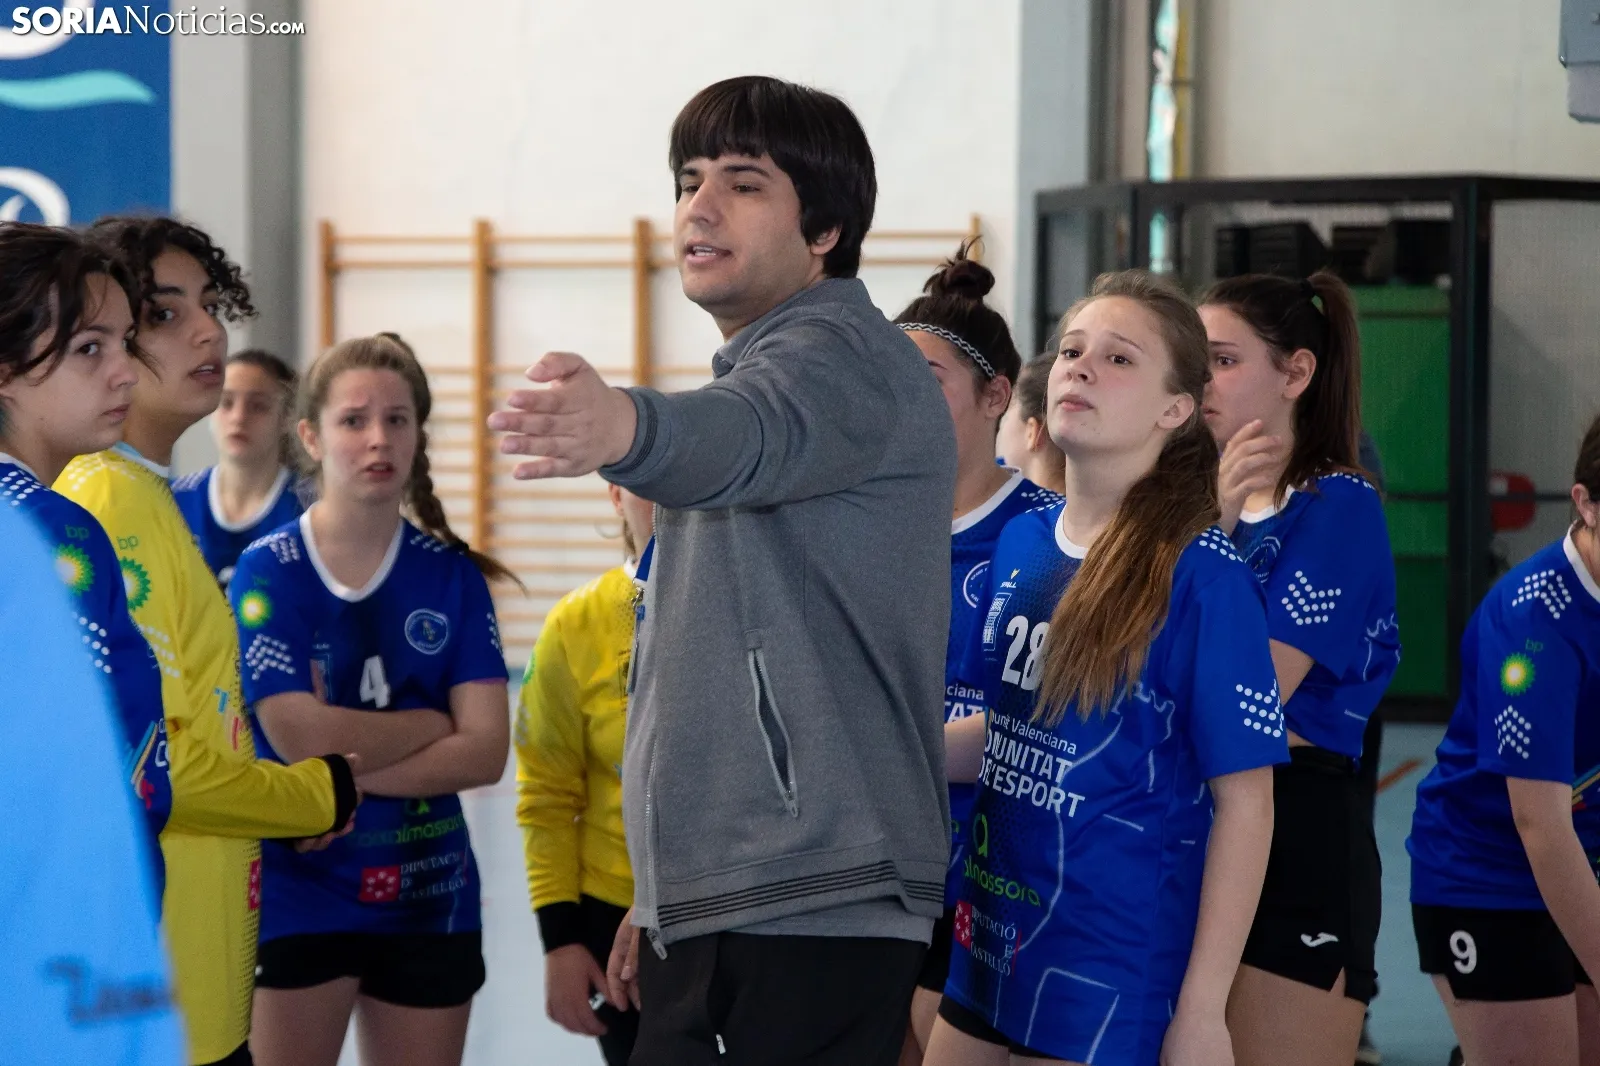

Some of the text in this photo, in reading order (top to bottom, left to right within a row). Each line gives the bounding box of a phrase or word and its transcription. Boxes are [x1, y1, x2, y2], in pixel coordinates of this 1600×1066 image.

[65, 524, 90, 539] bp
[116, 535, 139, 551] bp
[1002, 615, 1050, 690] 28
[1525, 638, 1544, 652] bp
[360, 655, 391, 708] 4
[946, 684, 985, 700] ciana
[1011, 718, 1077, 755] Valenciana
[1450, 930, 1477, 974] 9
